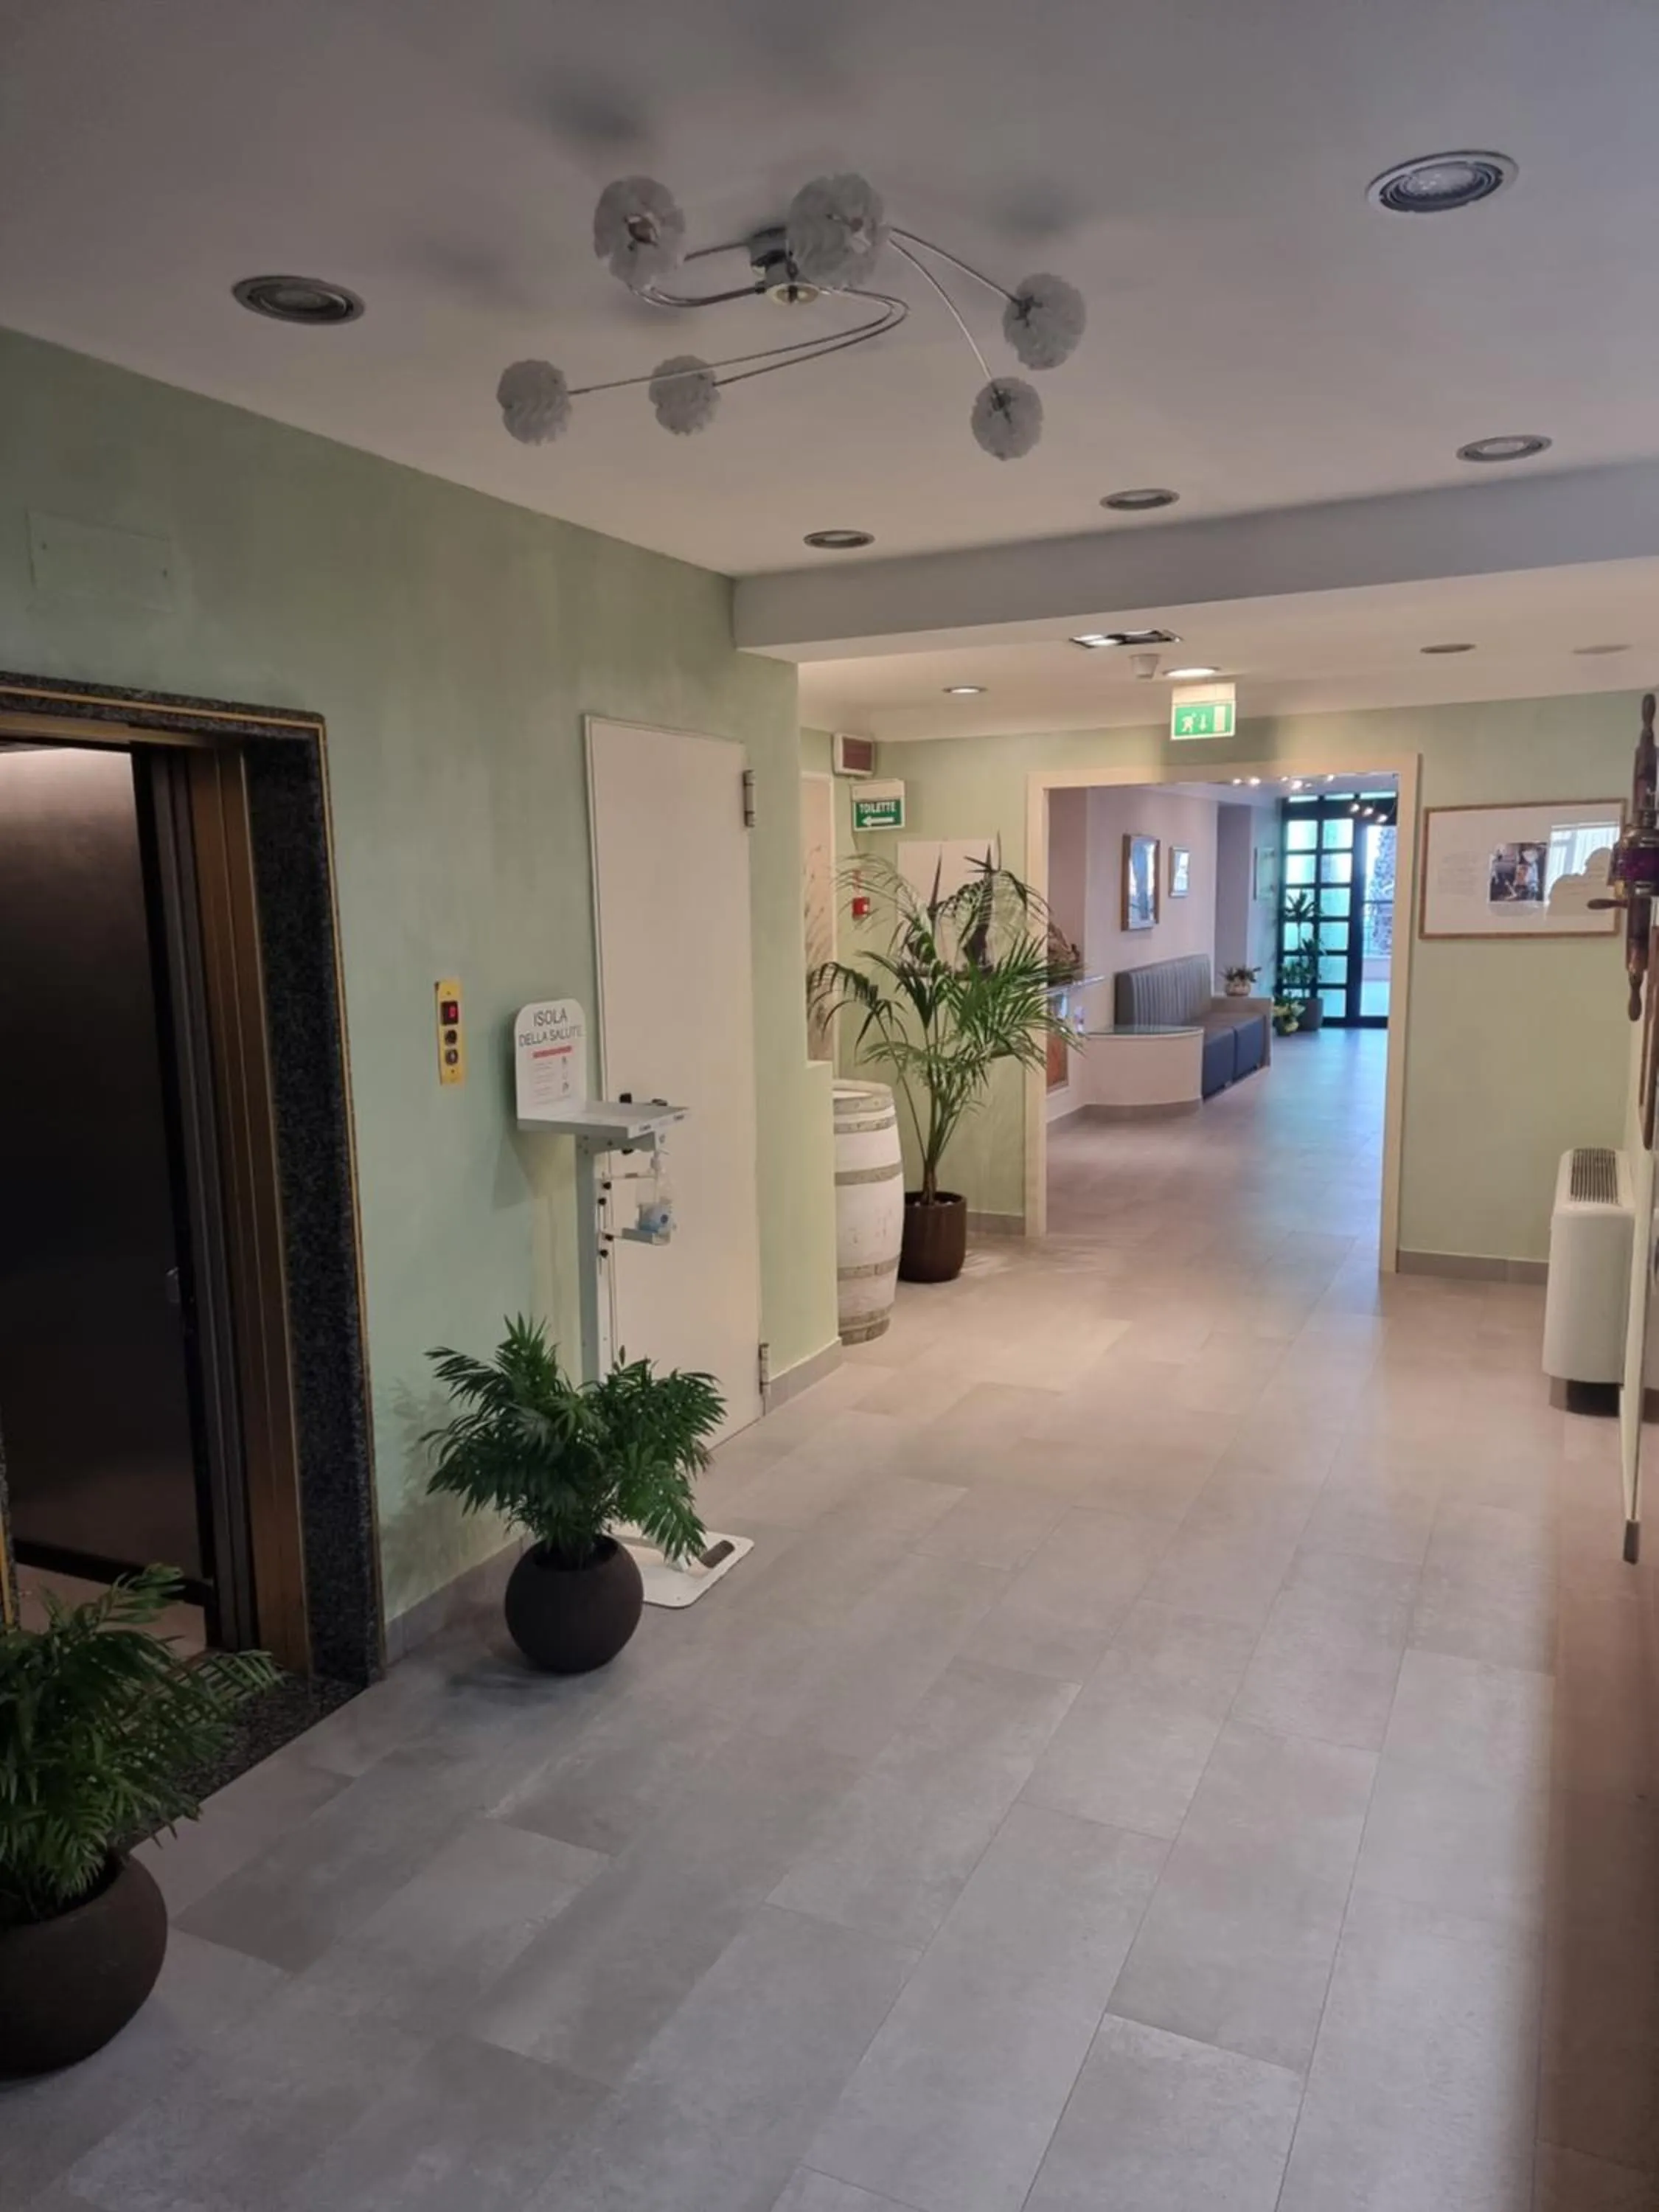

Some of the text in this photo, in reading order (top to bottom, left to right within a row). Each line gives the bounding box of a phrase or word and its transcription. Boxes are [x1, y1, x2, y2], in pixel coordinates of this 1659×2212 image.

[860, 801, 896, 814] TOILETTE
[533, 1007, 568, 1027] ISOLA
[518, 1032, 548, 1047] DELLA
